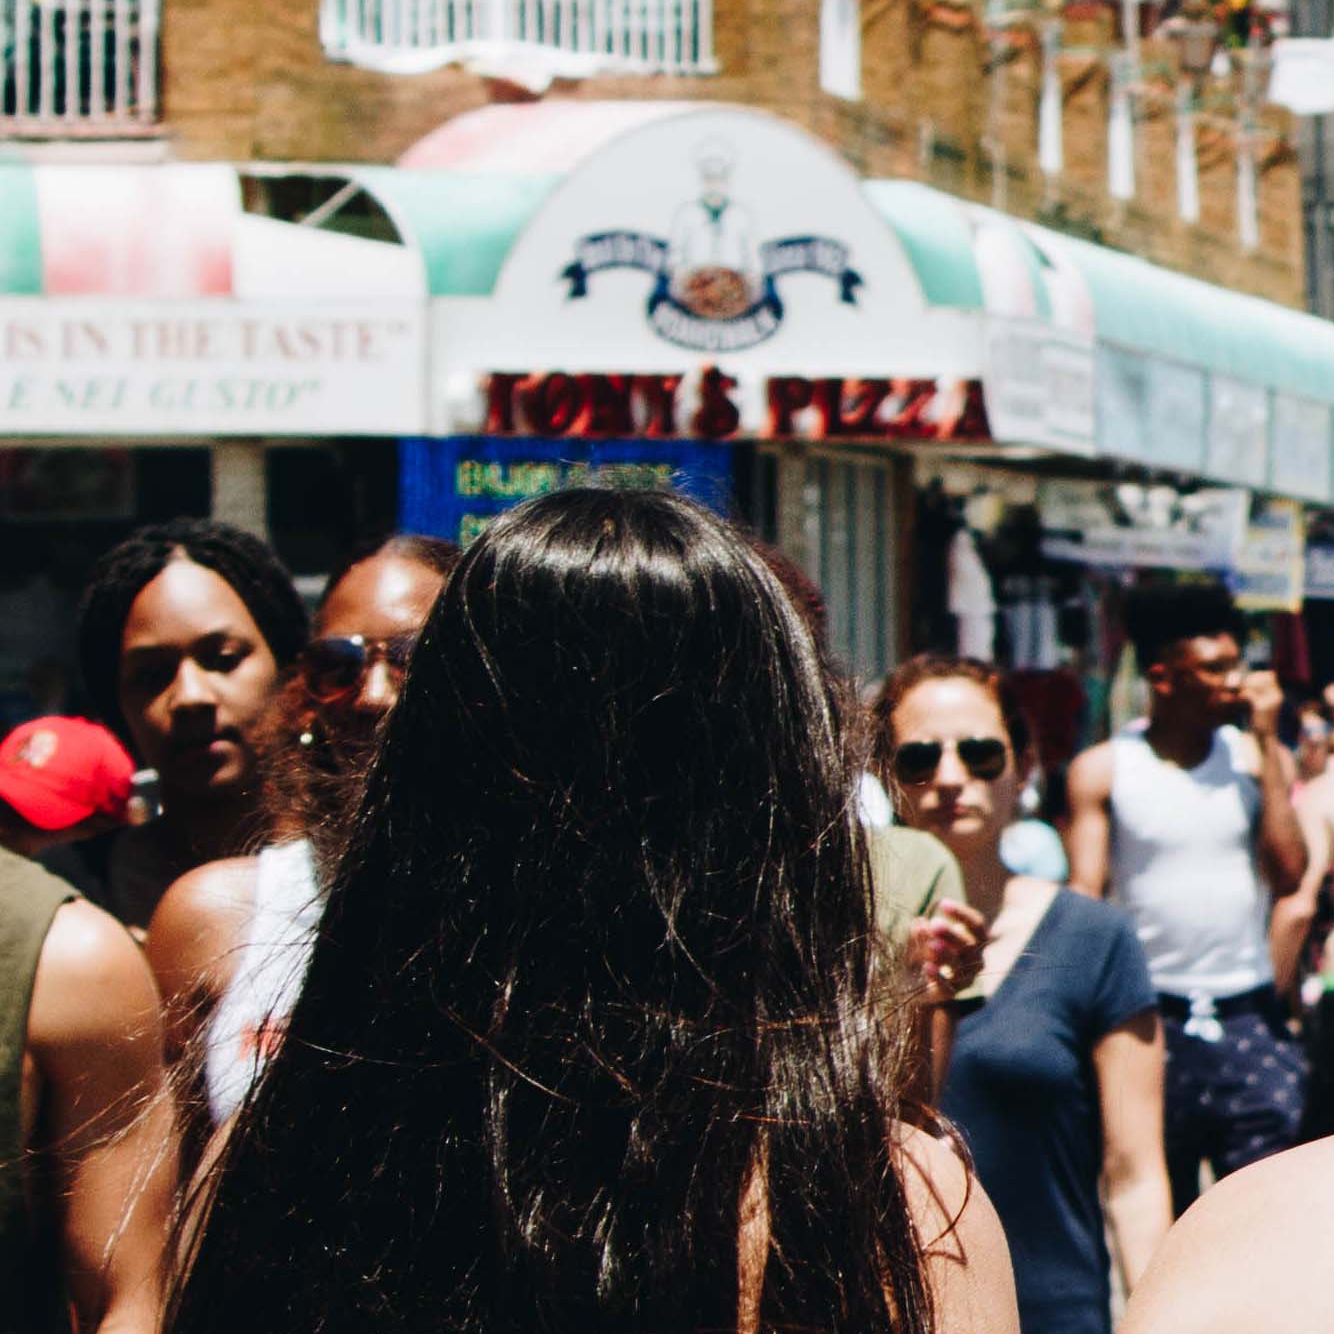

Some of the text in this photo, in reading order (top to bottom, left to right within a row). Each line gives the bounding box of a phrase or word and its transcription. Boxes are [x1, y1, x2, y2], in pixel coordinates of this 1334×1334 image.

[60, 320, 110, 362] IN
[129, 320, 214, 362] THE
[765, 376, 993, 442] PIZZA
